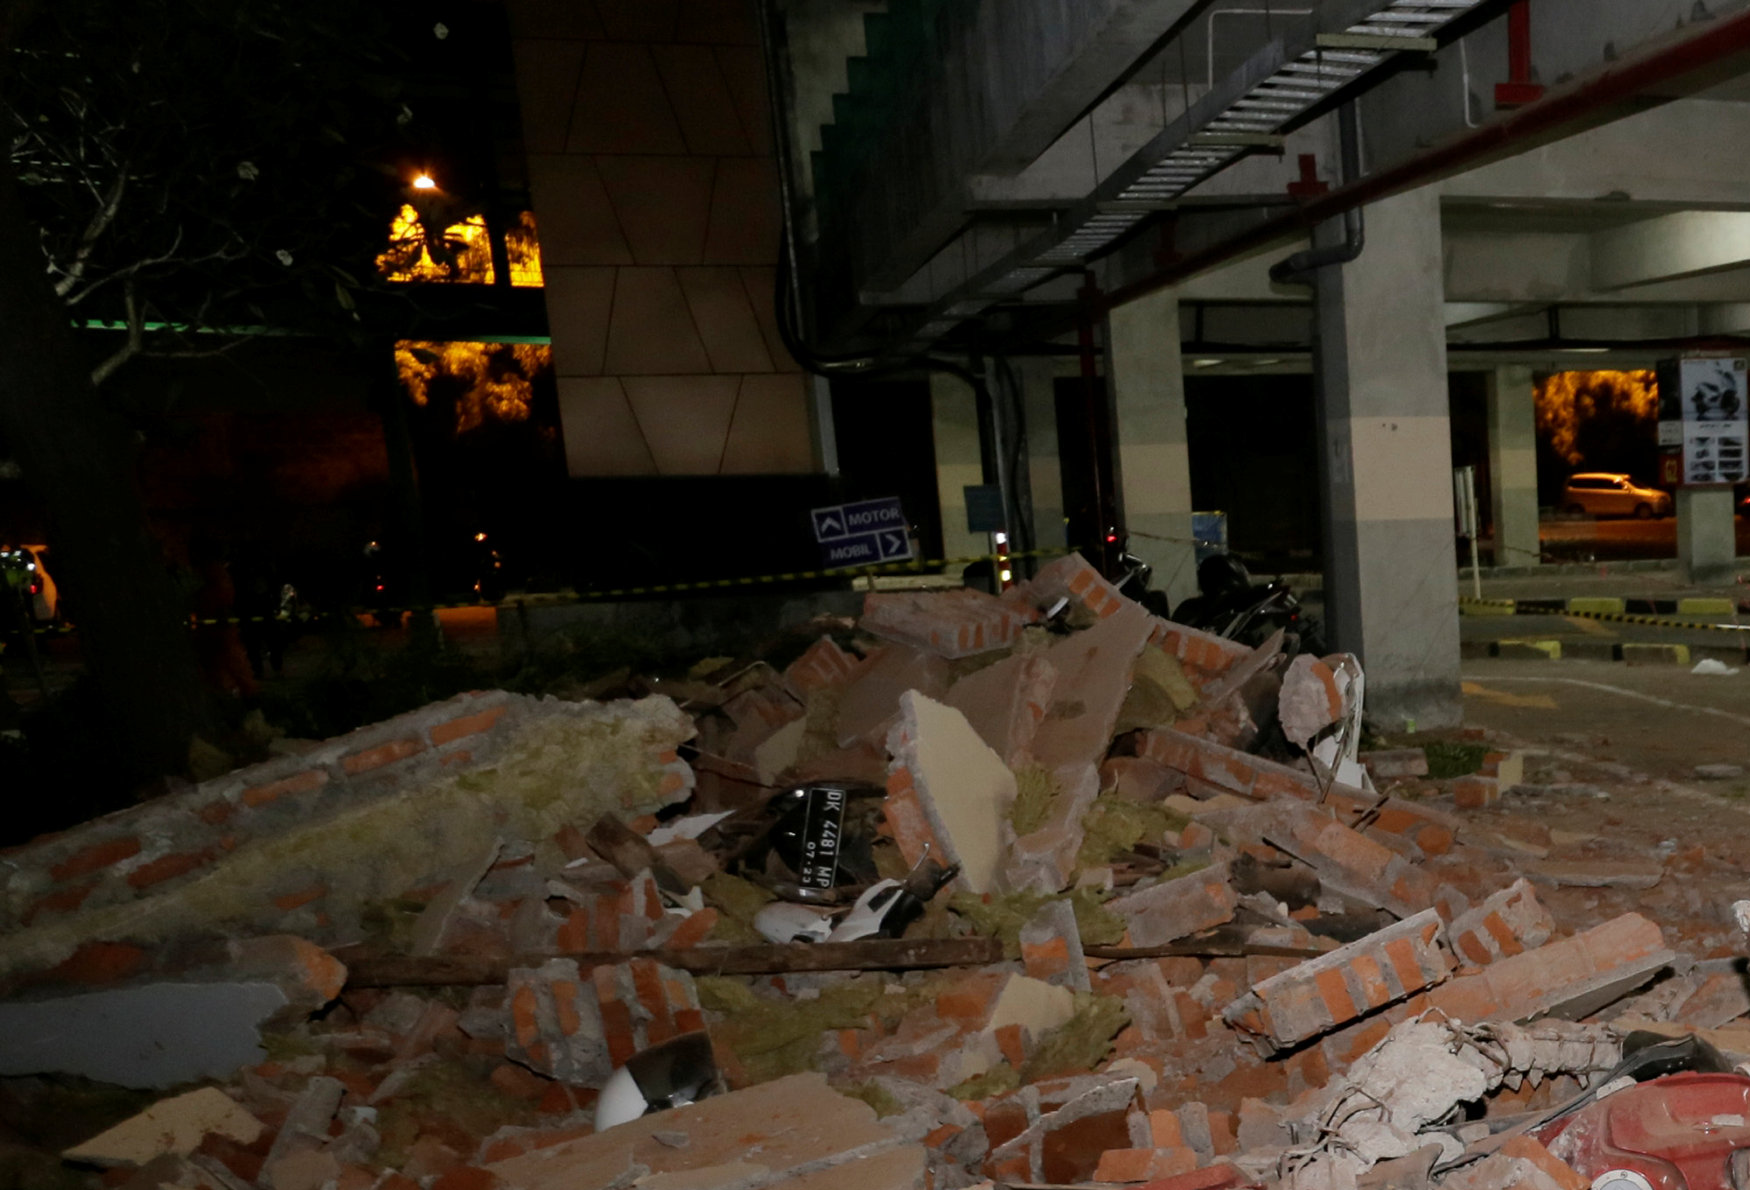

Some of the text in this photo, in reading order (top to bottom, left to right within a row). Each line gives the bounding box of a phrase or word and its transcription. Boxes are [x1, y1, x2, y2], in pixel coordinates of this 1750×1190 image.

[848, 507, 900, 526] MOTOR
[830, 543, 872, 560] MOBIL
[816, 791, 842, 887] DK 4481 MP
